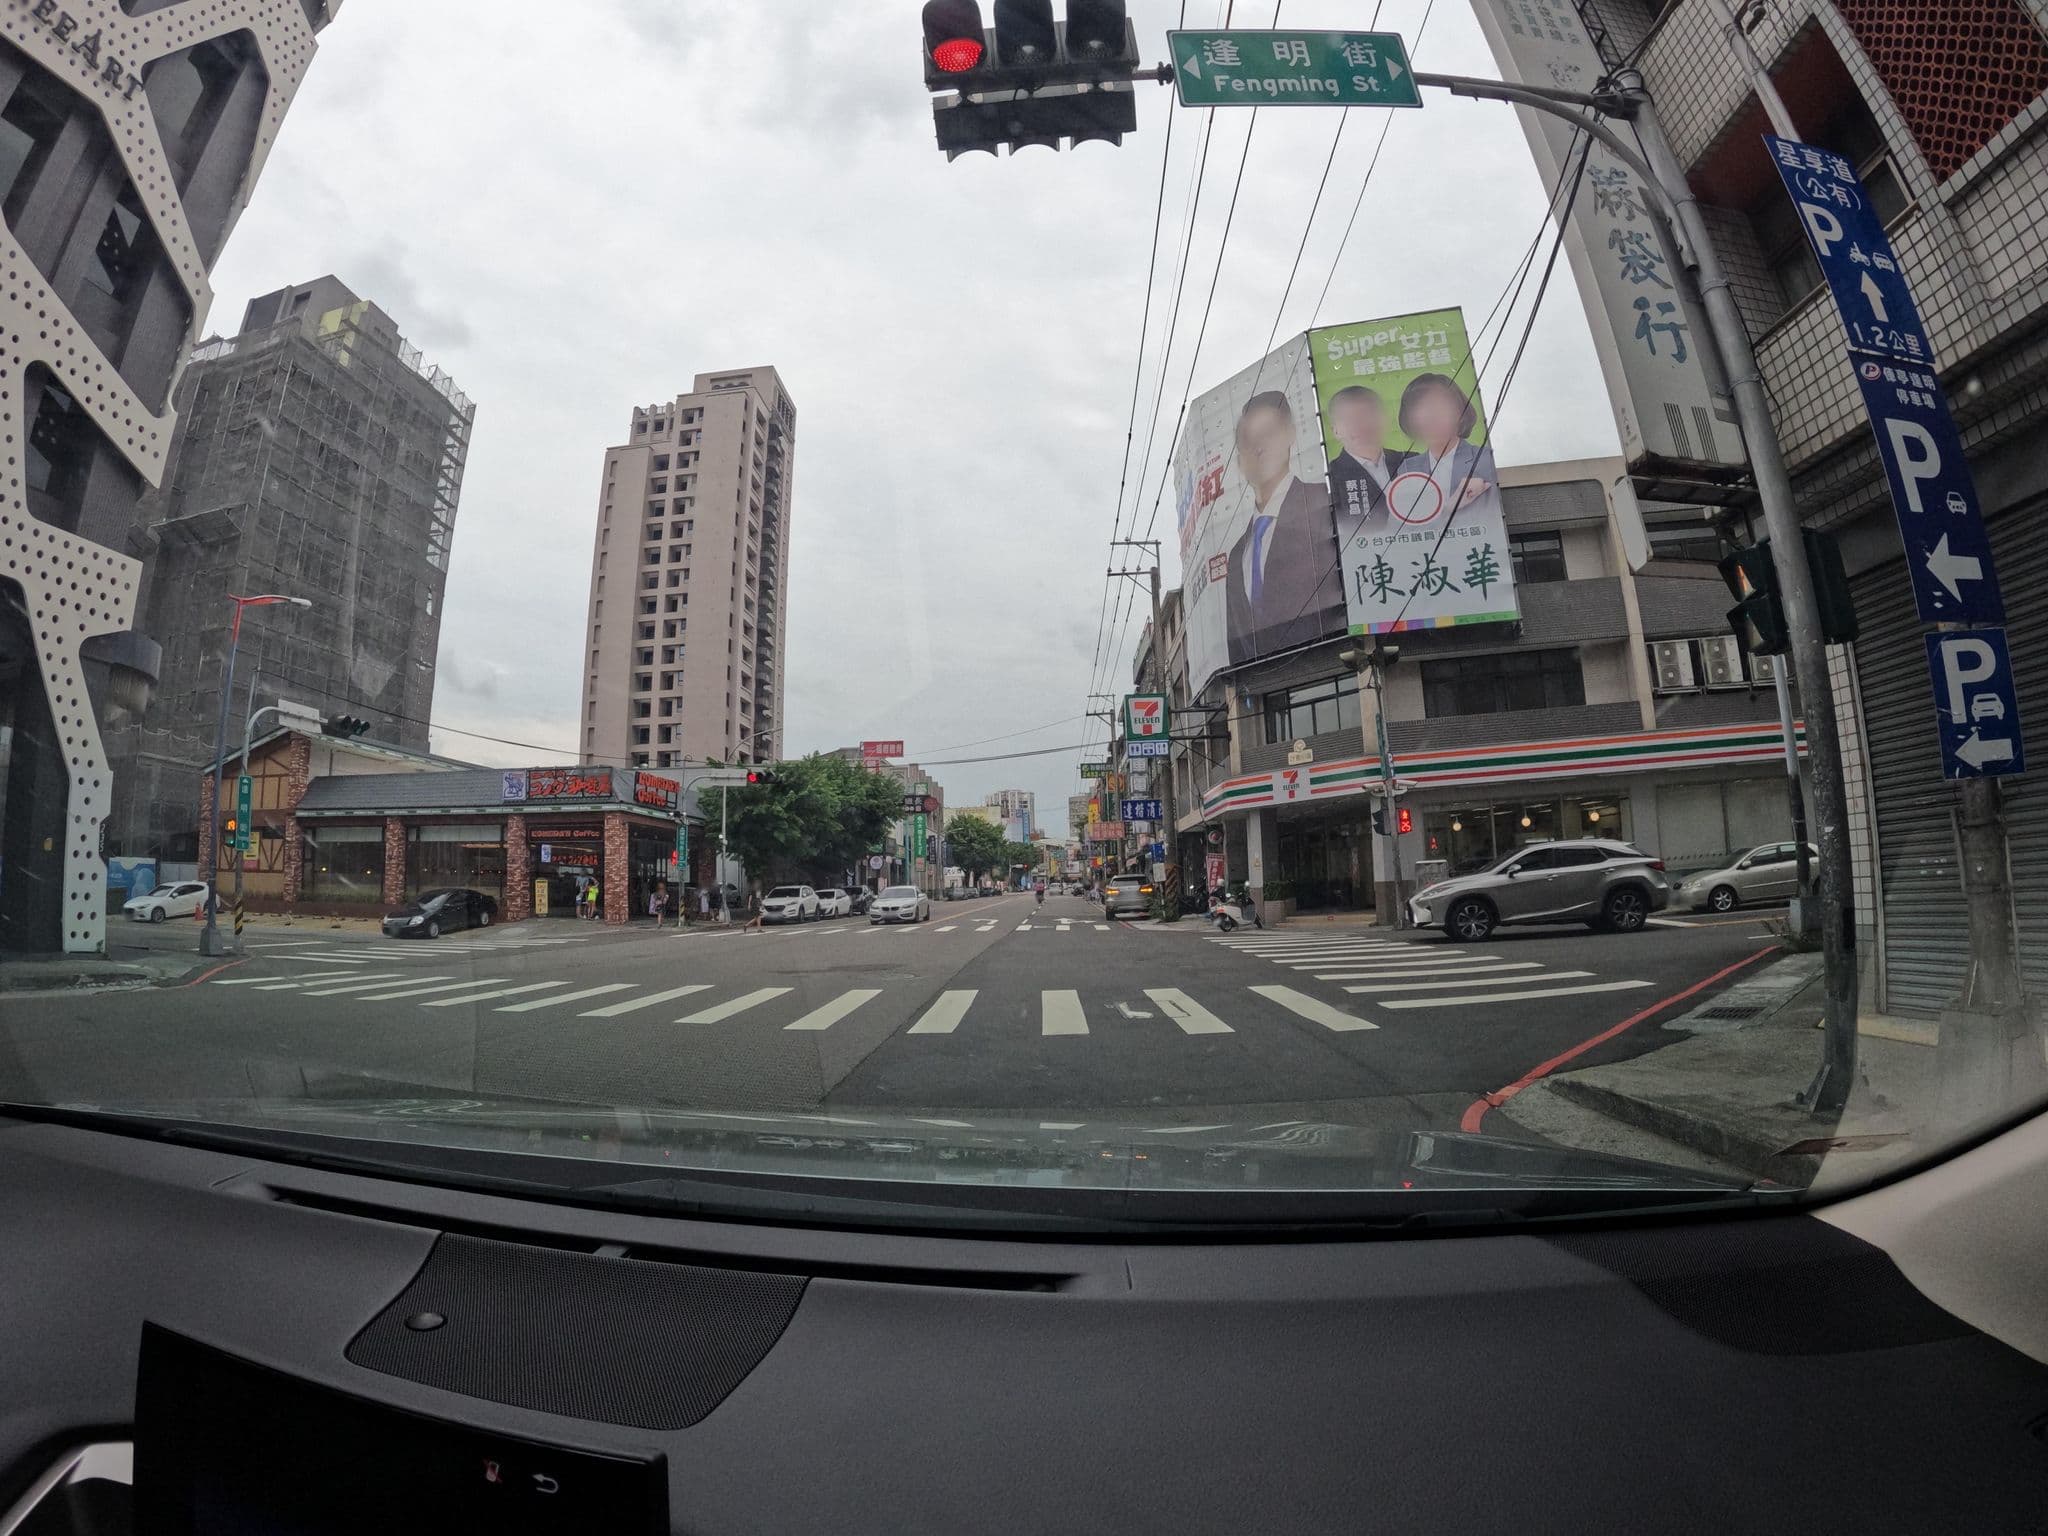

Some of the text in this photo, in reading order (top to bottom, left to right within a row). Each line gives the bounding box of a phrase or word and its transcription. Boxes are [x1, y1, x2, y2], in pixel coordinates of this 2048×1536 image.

[1203, 39, 1379, 69] 逢明街
[1214, 75, 1387, 98] Fengming St.
[1775, 140, 1856, 184] 星享道
[1800, 201, 1844, 257] P
[1327, 326, 1399, 361] Super
[1885, 417, 1941, 513] P
[1355, 542, 1501, 606] 陳淑華
[1941, 638, 1997, 725] P
